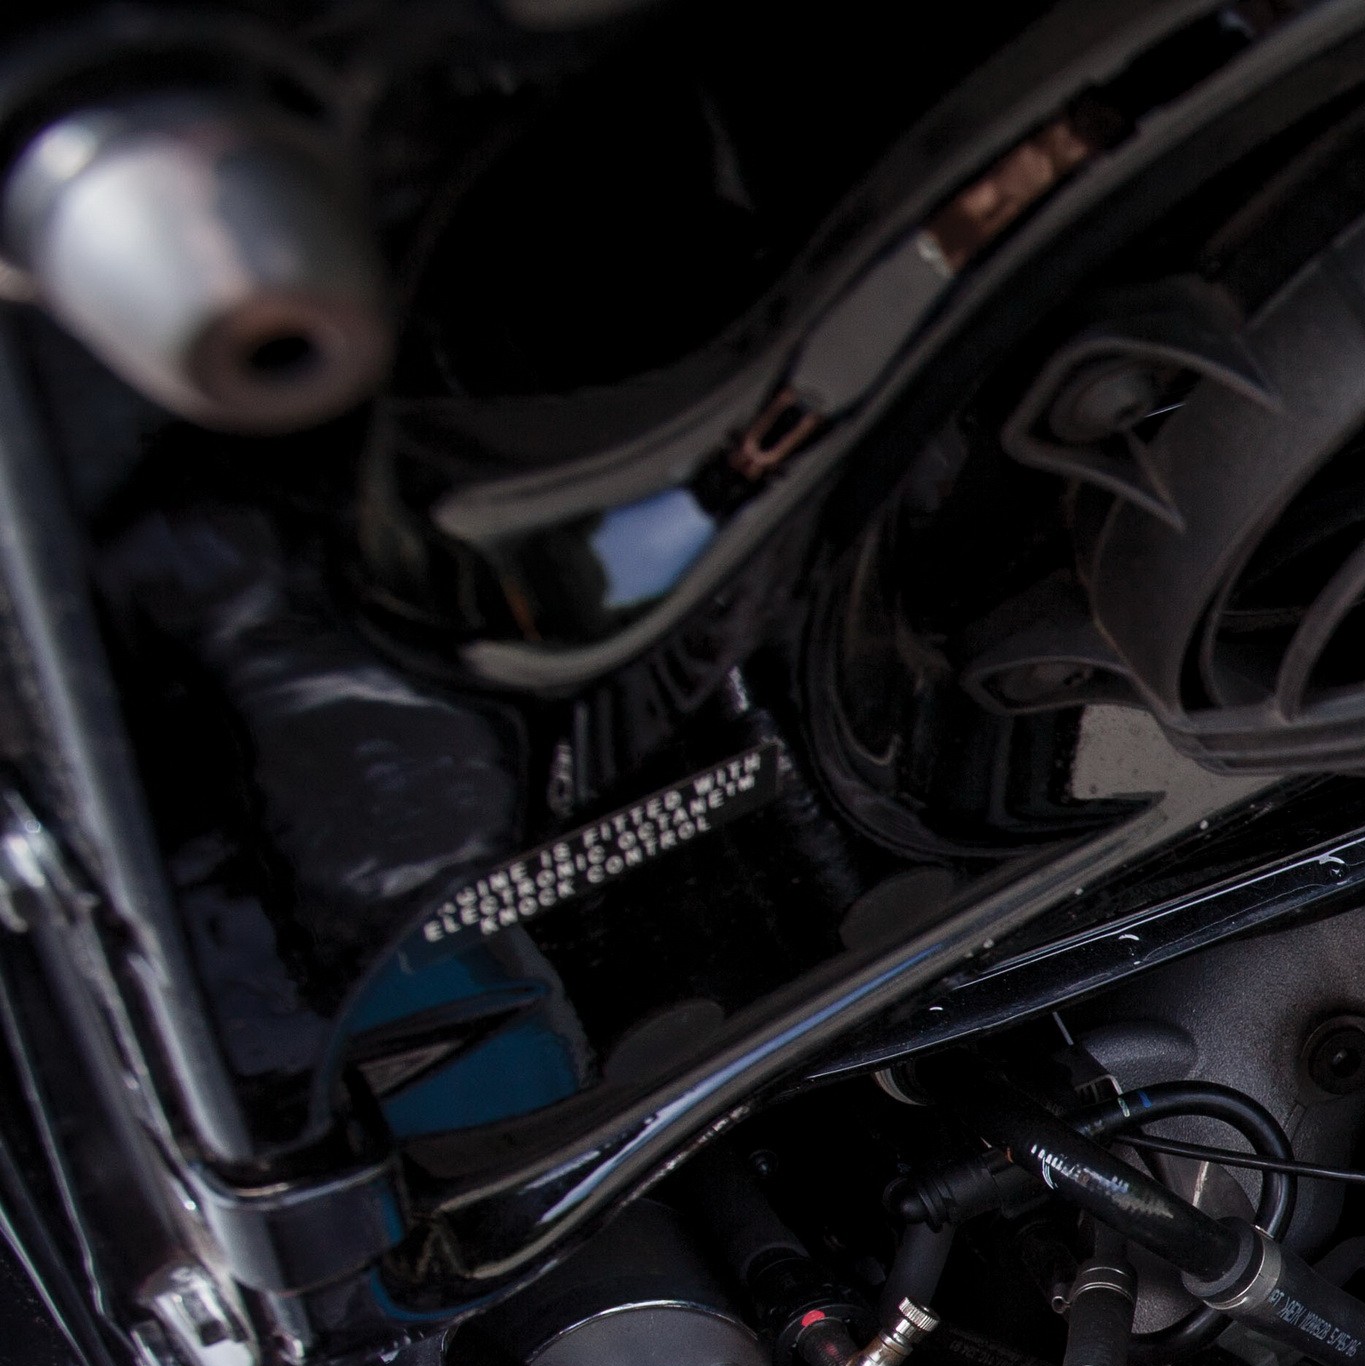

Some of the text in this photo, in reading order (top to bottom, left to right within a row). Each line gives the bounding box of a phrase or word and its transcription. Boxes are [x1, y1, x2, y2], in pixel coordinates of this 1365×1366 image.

[424, 843, 606, 943] ELECTRONIC
[438, 752, 762, 917] GINE IS FITTED WITH
[479, 814, 712, 936] KNOCK CONTROL
